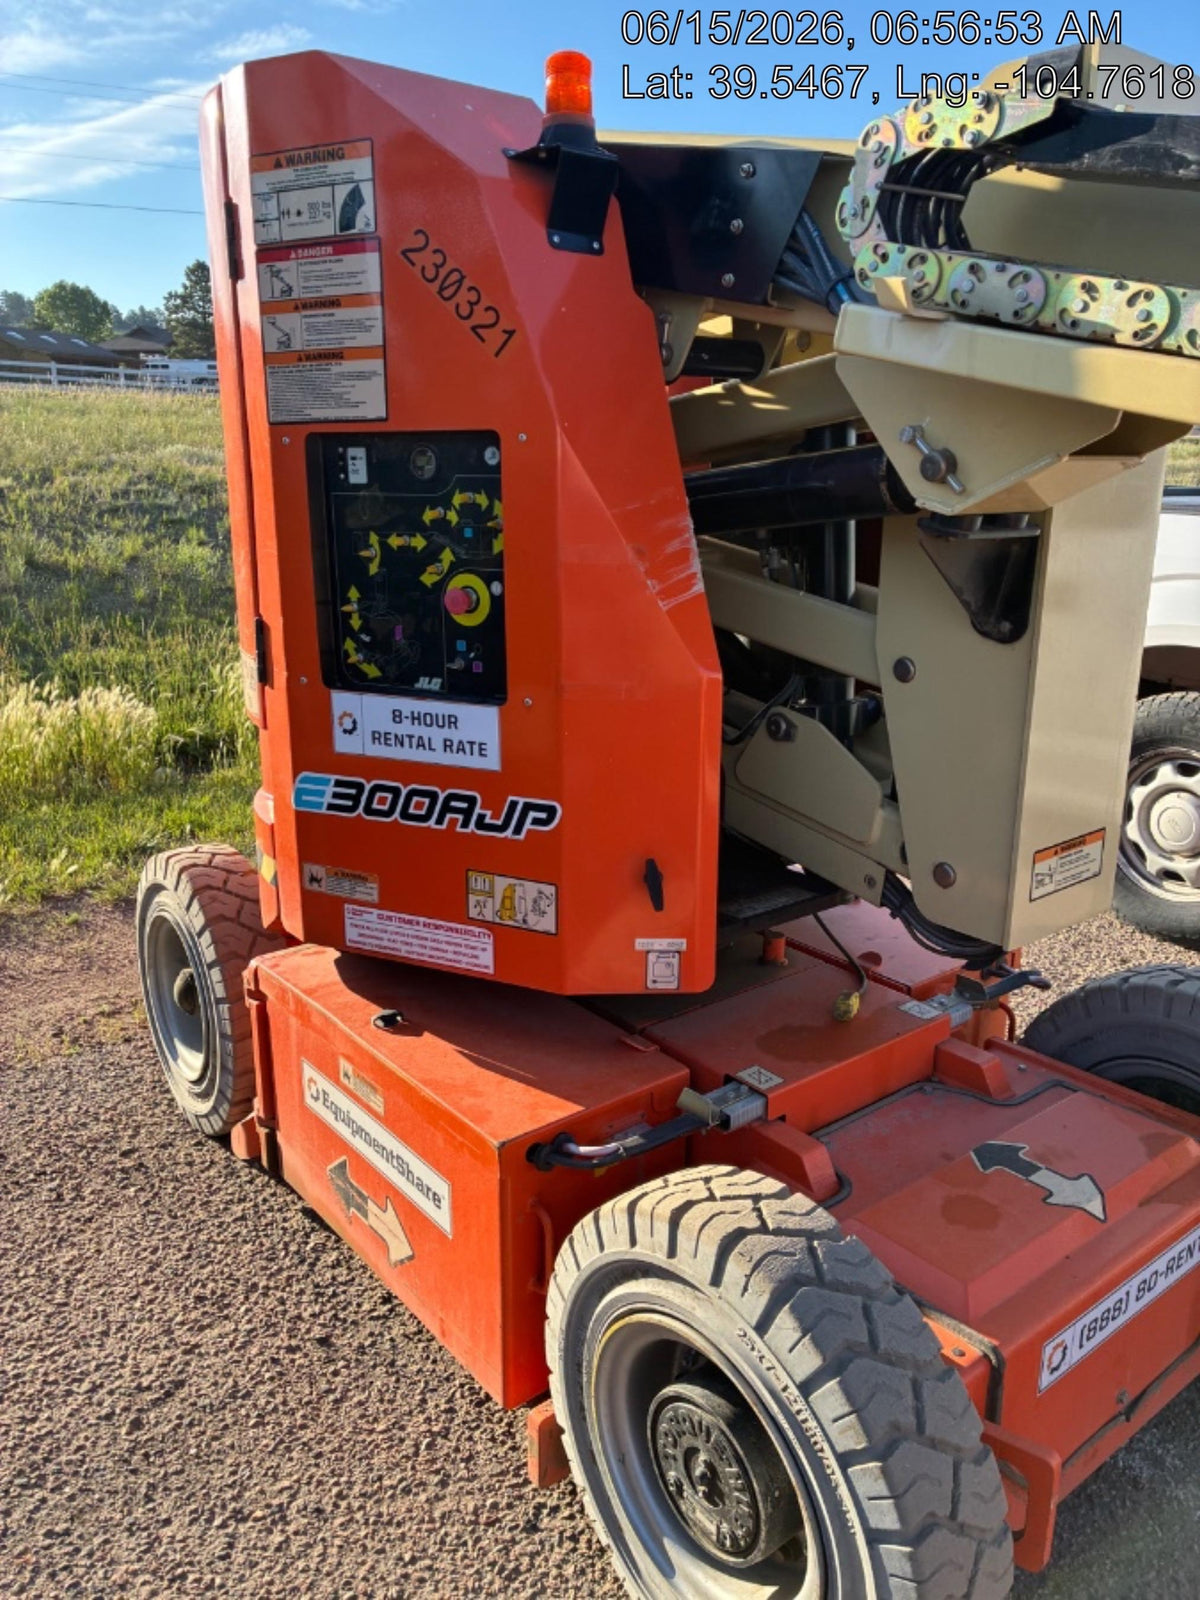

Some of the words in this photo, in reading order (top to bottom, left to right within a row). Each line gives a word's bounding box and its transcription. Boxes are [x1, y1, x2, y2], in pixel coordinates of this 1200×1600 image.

[284, 147, 345, 167] WARNING
[391, 709, 459, 730] 8-HOUR
[371, 730, 436, 753] RENTAL
[443, 737, 488, 758] RATE
[293, 774, 559, 838] E300AJP
[321, 1088, 443, 1210] EquipmentShare
